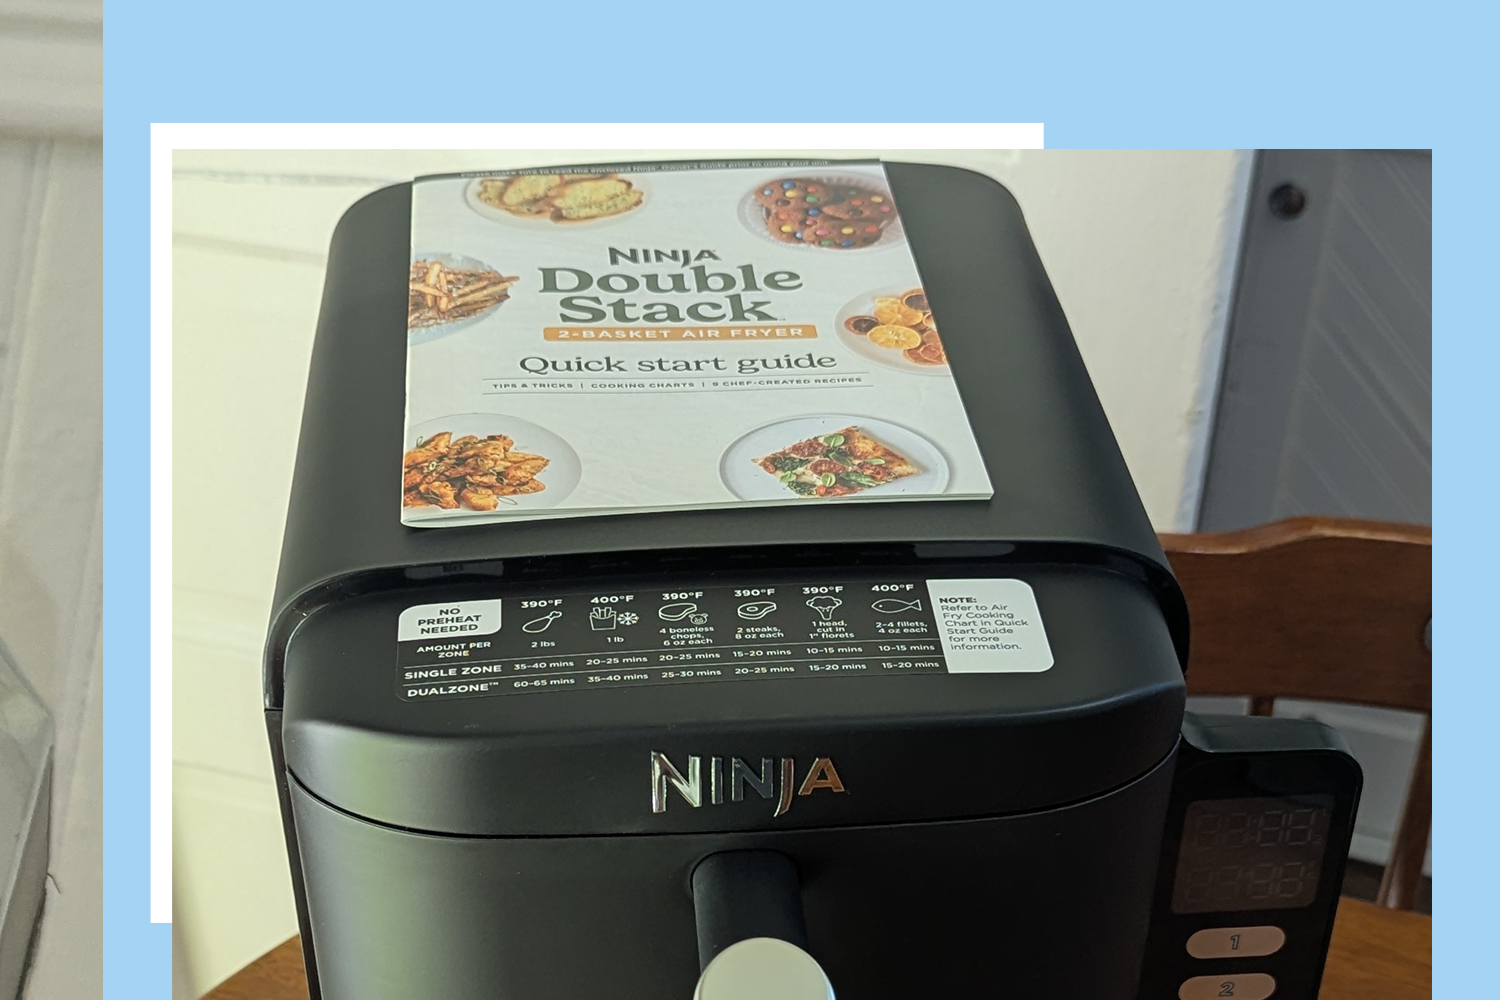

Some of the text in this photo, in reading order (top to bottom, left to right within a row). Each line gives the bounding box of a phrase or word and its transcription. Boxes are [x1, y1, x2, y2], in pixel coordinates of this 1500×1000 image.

[608, 246, 722, 268] NINJA
[537, 264, 804, 294] Double
[559, 293, 779, 323] Stack
[557, 328, 804, 339] 2-BASKET AIR FRYER
[519, 353, 838, 375] Quick start guide
[722, 379, 811, 387] CHEF-CREATED
[802, 585, 844, 595] 390°F
[871, 583, 915, 592] 400°F
[662, 591, 704, 601] 390°F
[734, 588, 776, 598] 390°F
[590, 594, 635, 604] 400°F
[520, 599, 563, 609] 390°F
[943, 611, 1014, 620] Fry Cooking
[418, 615, 482, 626] PREHEAT
[945, 619, 978, 627] Chart
[994, 619, 1028, 627] Quick
[420, 624, 479, 635] NEEDED
[669, 626, 715, 634] boneless
[759, 631, 784, 639] each
[821, 631, 854, 639] florets
[416, 641, 491, 653] AMOUNT PER
[540, 640, 556, 648] lbs
[910, 643, 935, 651] mins
[766, 648, 792, 656] mins
[837, 645, 863, 653] mins
[438, 650, 470, 659] ZONE
[622, 655, 648, 663] mins
[549, 659, 575, 668] mins
[842, 662, 867, 670] mins
[915, 660, 940, 668] mins
[404, 665, 502, 680] SINGLE ZONE
[696, 668, 722, 676] mins
[770, 665, 795, 673] mins
[623, 672, 649, 680] mins
[550, 677, 575, 685] mins
[651, 750, 846, 817] NINJA
[1230, 934, 1241, 950] 1
[1218, 981, 1234, 998] 2
